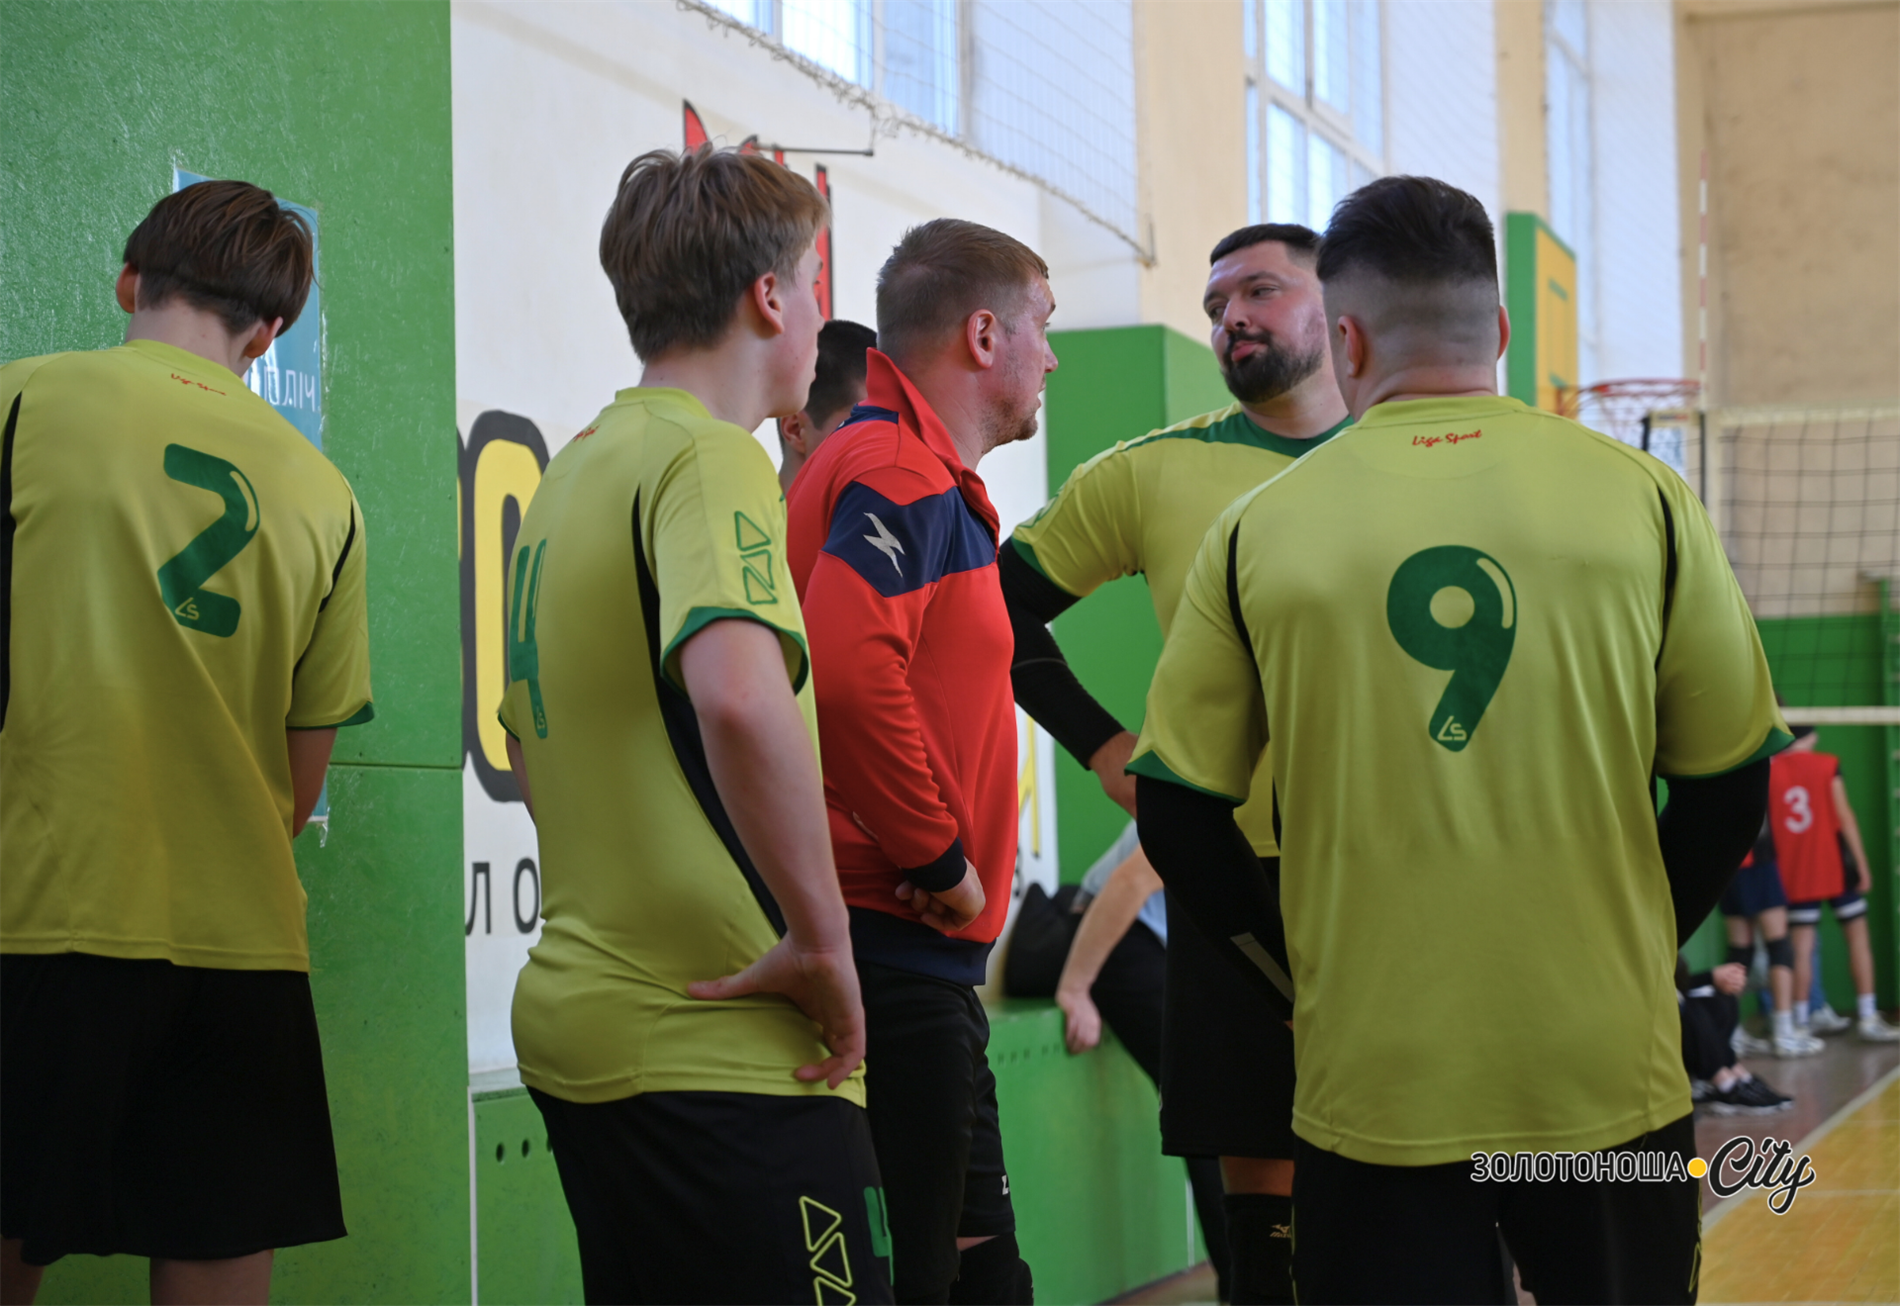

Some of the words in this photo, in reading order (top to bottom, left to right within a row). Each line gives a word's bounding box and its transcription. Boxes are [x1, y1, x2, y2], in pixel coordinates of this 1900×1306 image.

[157, 443, 260, 637] 2
[509, 538, 548, 739] 4
[1387, 545, 1517, 752] 9
[1784, 786, 1813, 834] 3
